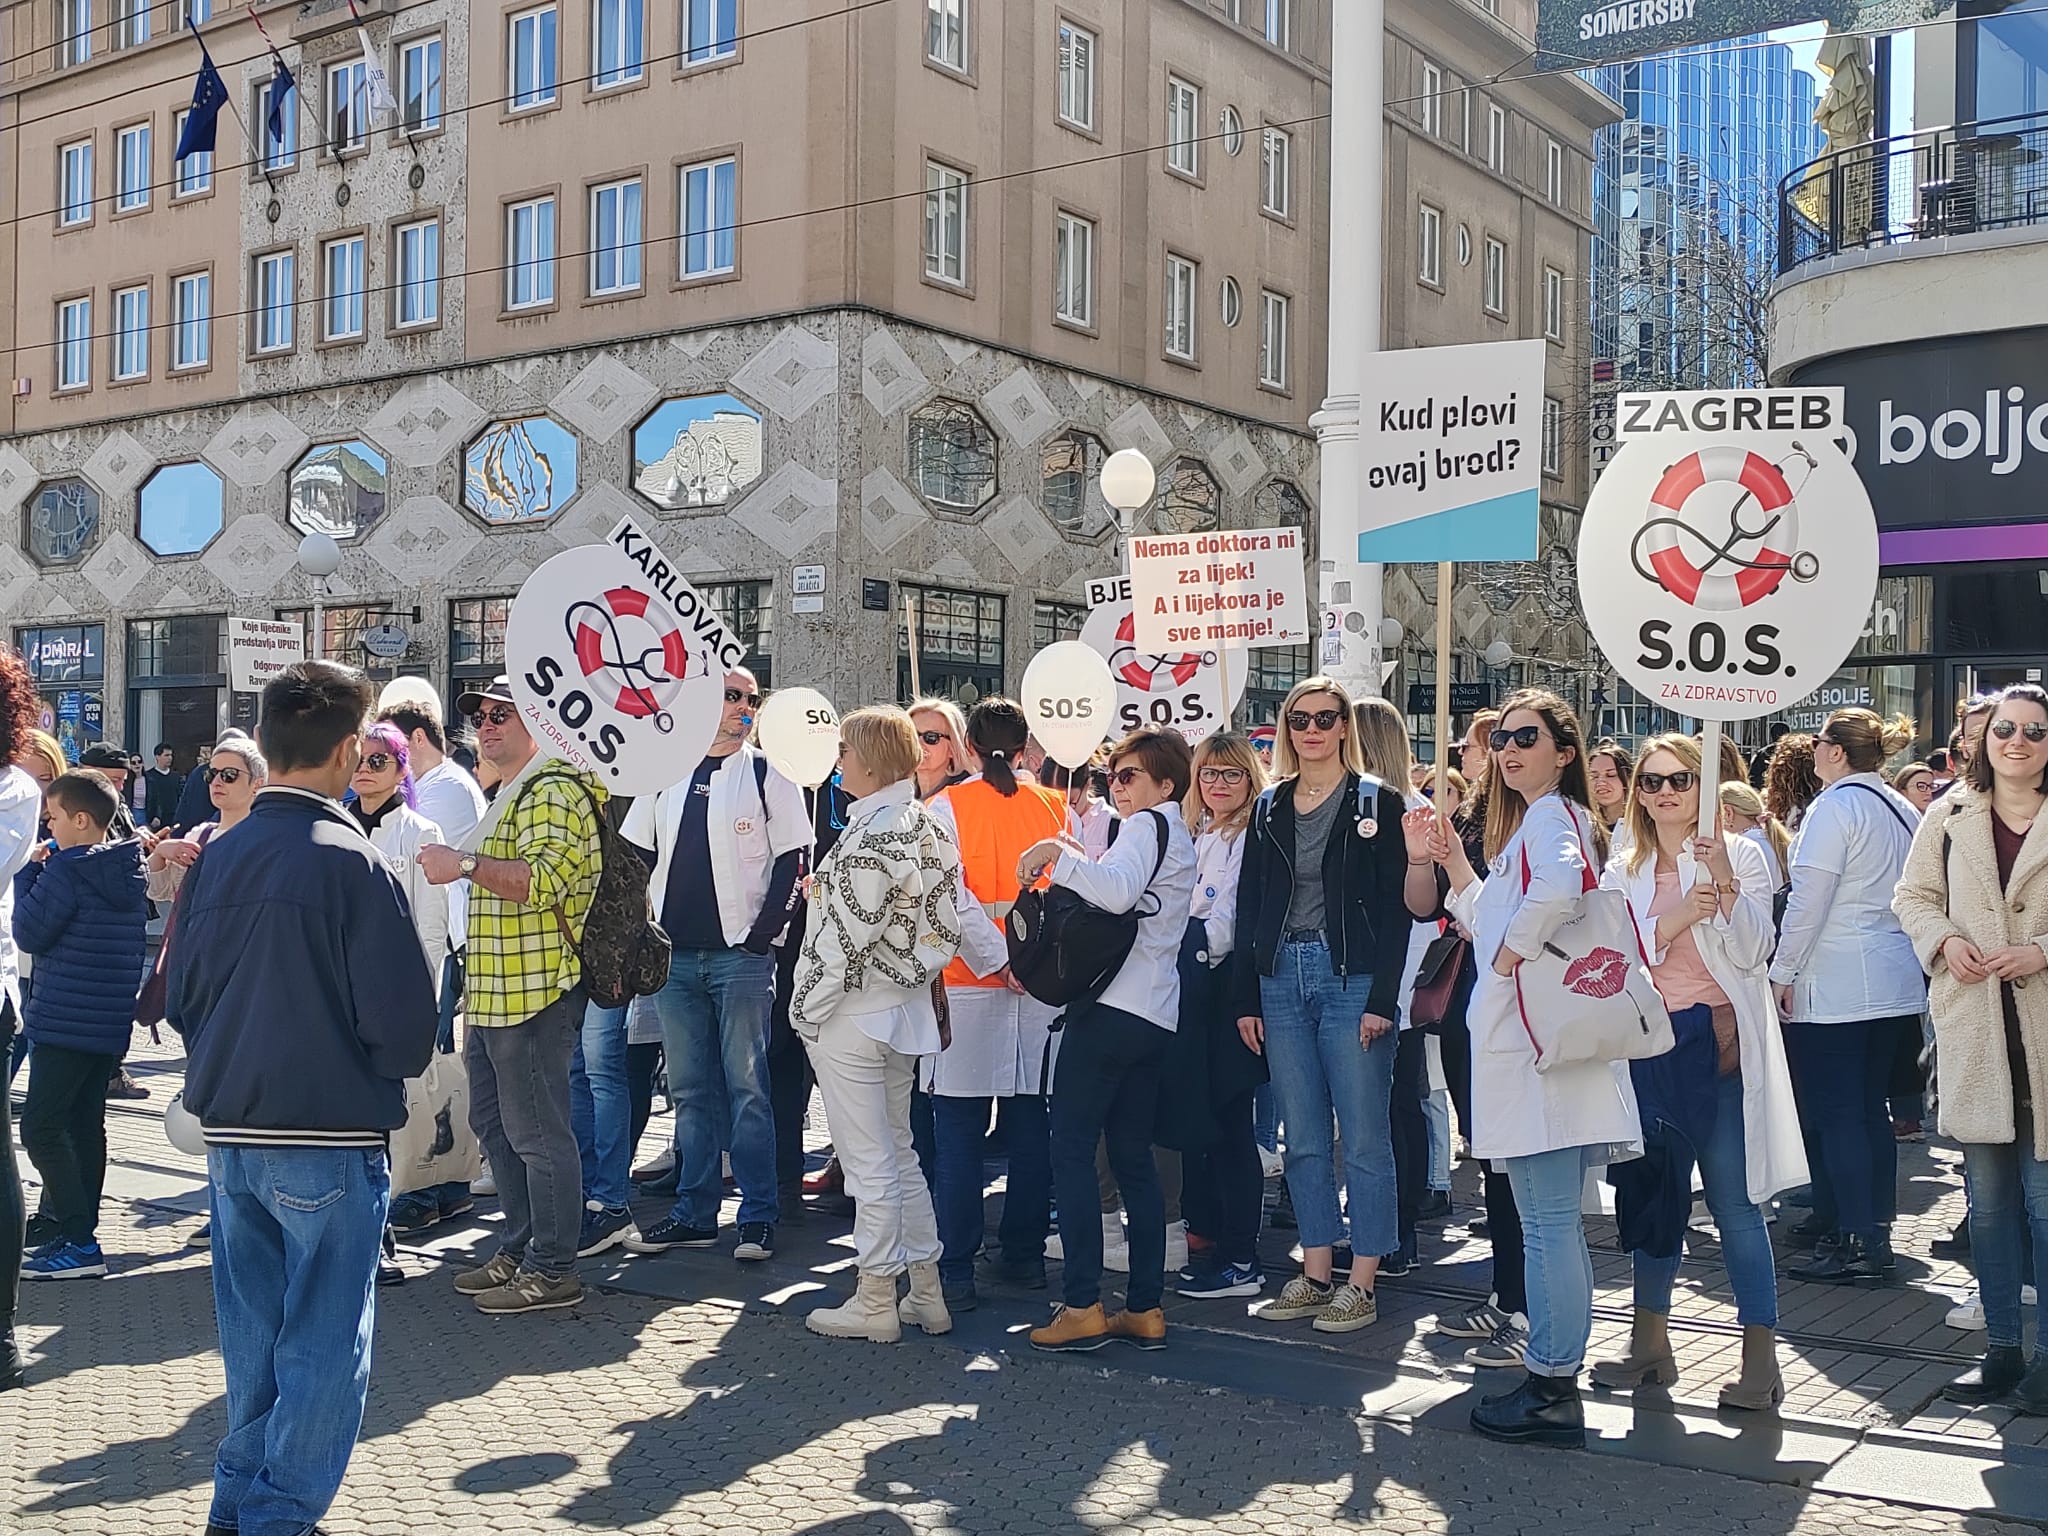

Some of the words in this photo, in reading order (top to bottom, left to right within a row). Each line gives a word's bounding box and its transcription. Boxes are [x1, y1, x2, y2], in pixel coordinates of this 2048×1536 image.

[1579, 0, 1696, 40] SOMERSBY
[1380, 398, 1433, 432] Kud
[1442, 392, 1517, 437] plovi
[1623, 395, 1832, 433] ZAGREB
[1369, 451, 1426, 492] ovaj
[1435, 439, 1521, 479] brod?
[1134, 540, 1190, 558] Nema
[1196, 534, 1271, 554] doktora
[1277, 530, 1296, 549] ni
[1178, 569, 1200, 584] za
[1206, 562, 1255, 585] lijek!
[615, 523, 741, 670] KARLOVAC
[1153, 597, 1168, 614] A
[1173, 596, 1179, 613] i
[1186, 592, 1261, 615] lijekova
[1266, 589, 1285, 610] je
[242, 620, 259, 633] Koje
[1167, 626, 1201, 642] sve
[1207, 618, 1273, 640] manje!
[31, 638, 95, 660] ADMIRAL
[233, 637, 276, 650] predstavlja
[277, 639, 300, 650] UPUZ?
[1637, 619, 1796, 677] S.O.S.
[1459, 686, 1480, 695] Steak
[1661, 683, 1681, 698] ZA
[1685, 685, 1777, 704] ZDRAVSTVO
[1822, 686, 1875, 706] BOLJE,
[85, 703, 101, 712] OPEN
[524, 703, 541, 723] ZA
[525, 655, 626, 777] S.O.S.
[806, 709, 839, 728] SOS
[1039, 697, 1093, 719] SOS
[785, 876, 803, 912] JEANS
